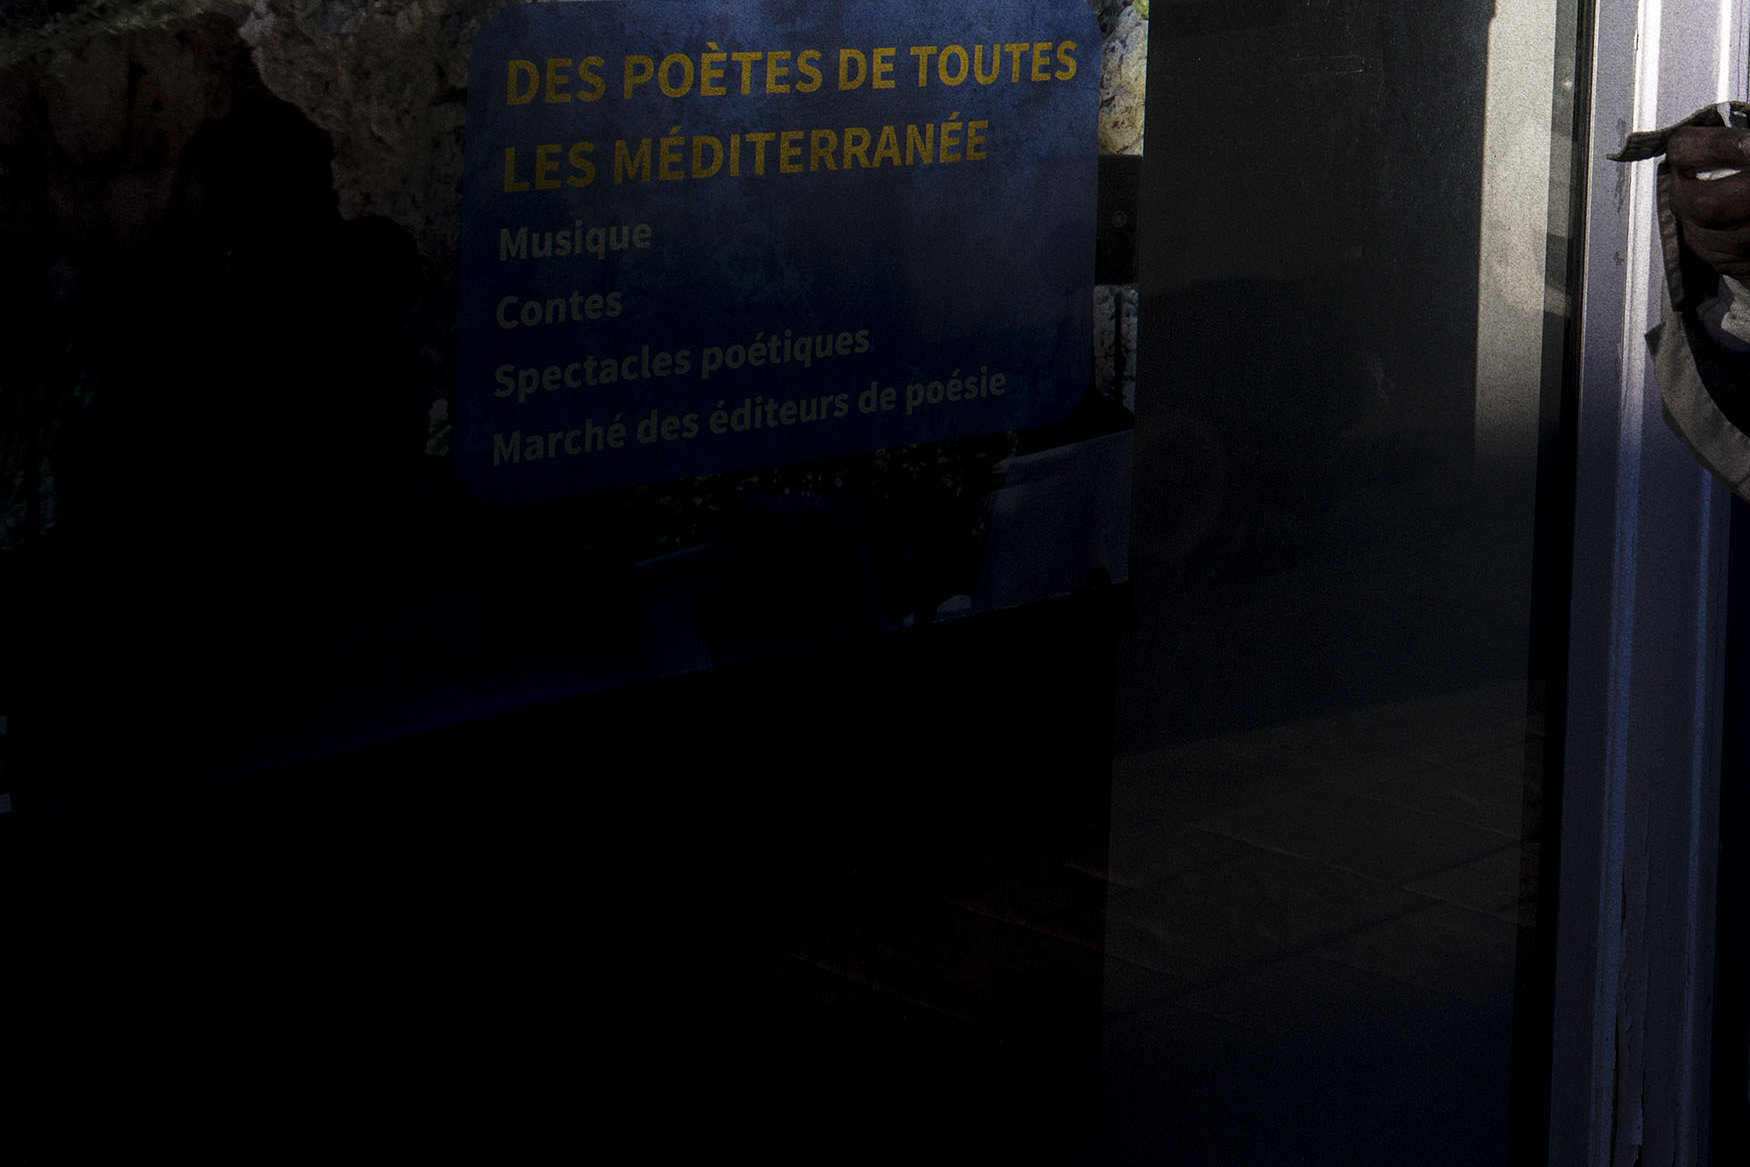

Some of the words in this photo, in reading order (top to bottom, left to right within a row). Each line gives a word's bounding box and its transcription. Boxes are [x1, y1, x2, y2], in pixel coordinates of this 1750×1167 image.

[506, 55, 606, 106] DES
[622, 41, 823, 100] POÈTES
[837, 46, 896, 92] DE
[909, 39, 1079, 88] TOUTES
[502, 139, 597, 194] LES
[612, 112, 990, 185] MÉDITERRANÉE
[497, 218, 653, 264] Musique
[495, 288, 624, 331] Contes
[493, 341, 692, 402] Spectacles
[700, 324, 871, 380] poétiques
[491, 413, 625, 466] Marché
[635, 405, 699, 447] des
[707, 386, 849, 437] éditeurs
[856, 380, 897, 417] de
[903, 361, 1006, 415] poésie
